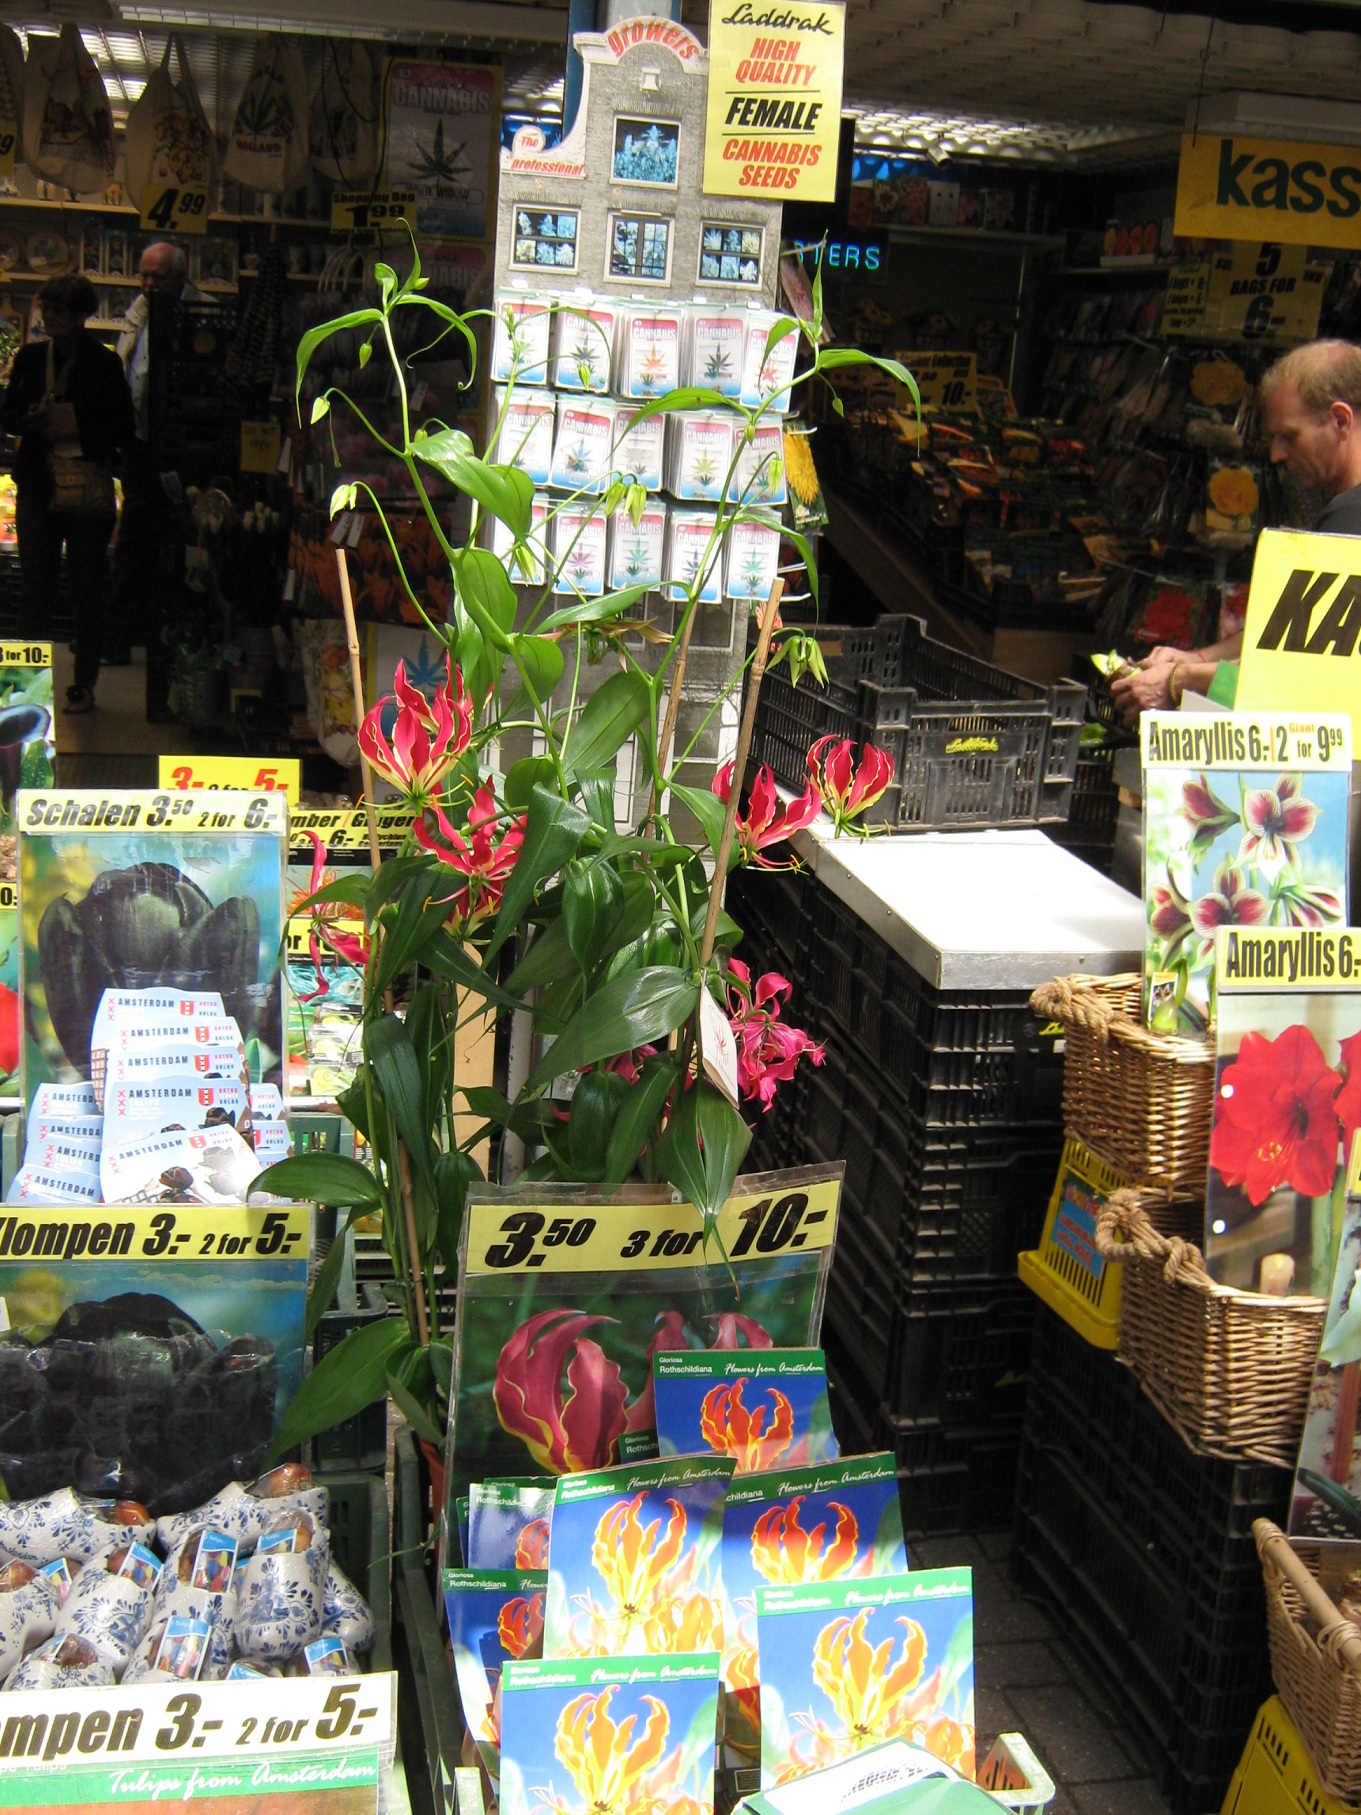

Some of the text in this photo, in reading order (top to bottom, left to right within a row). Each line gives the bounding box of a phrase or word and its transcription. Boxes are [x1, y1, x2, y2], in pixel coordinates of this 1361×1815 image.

[722, 3, 834, 35] Laddrak
[608, 20, 700, 61] growers
[750, 38, 801, 62] HIGH
[735, 60, 817, 86] QUALITY
[724, 97, 823, 131] FEMALE
[520, 136, 540, 149] The
[722, 139, 822, 167] CANNABIS
[511, 158, 584, 176] professional
[739, 165, 801, 189] SEEDS
[1216, 139, 1361, 218] kass
[333, 192, 415, 204] Shopping Bag
[148, 189, 206, 229] 4.99
[1256, 242, 1282, 277] 5
[1230, 278, 1296, 295] BAGS FOR
[633, 328, 676, 340] CANNABIS
[697, 327, 741, 339] CANNABIS
[751, 338, 793, 353] CAABIS
[564, 419, 608, 436] CANNABIS
[686, 431, 728, 444] CANNABIS
[619, 522, 661, 535] CANNABIS
[735, 531, 777, 545] CANNABIS
[6, 650, 21, 661] for
[1289, 722, 1315, 733] Giant
[1149, 722, 1245, 765] Amaryllis
[1276, 726, 1289, 762] 2
[1298, 740, 1312, 758] for
[26, 800, 138, 827] Schalen
[146, 796, 194, 827] 3.50
[198, 811, 209, 827] 2
[211, 812, 235, 827] for
[351, 812, 414, 828] Gger
[1226, 932, 1335, 982] Amaryllis
[118, 998, 175, 1007] AMSTERDAM
[131, 1027, 189, 1037] AMSTERDAM
[128, 1056, 188, 1066] AMSTERDAM
[129, 1089, 192, 1098] AMSTERDAM
[119, 1139, 183, 1160] AMSTERDAM
[34, 1175, 95, 1197] AMSTERDAM
[143, 1213, 191, 1256] 3.-
[199, 1233, 216, 1255] 2
[217, 1231, 252, 1255] for
[254, 1212, 302, 1256] 5.-
[485, 1193, 828, 1268] 3.50 3 for 10.-
[659, 1361, 824, 1378] Rothschildiana Flowers from Amsterdam
[626, 1467, 731, 1491] Flowers from Amsterdam
[777, 1467, 894, 1496] Flowers from Amsterdam
[561, 1484, 615, 1500] Rothschildiana
[726, 1489, 763, 1501] childiana
[450, 1580, 507, 1588] Rothschildiana
[155, 1693, 223, 1750] 3.-
[235, 1717, 258, 1745] 2
[263, 1714, 310, 1743] for
[315, 1684, 378, 1740] 5.-
[109, 1757, 376, 1802] Tulips from Amsterdam
